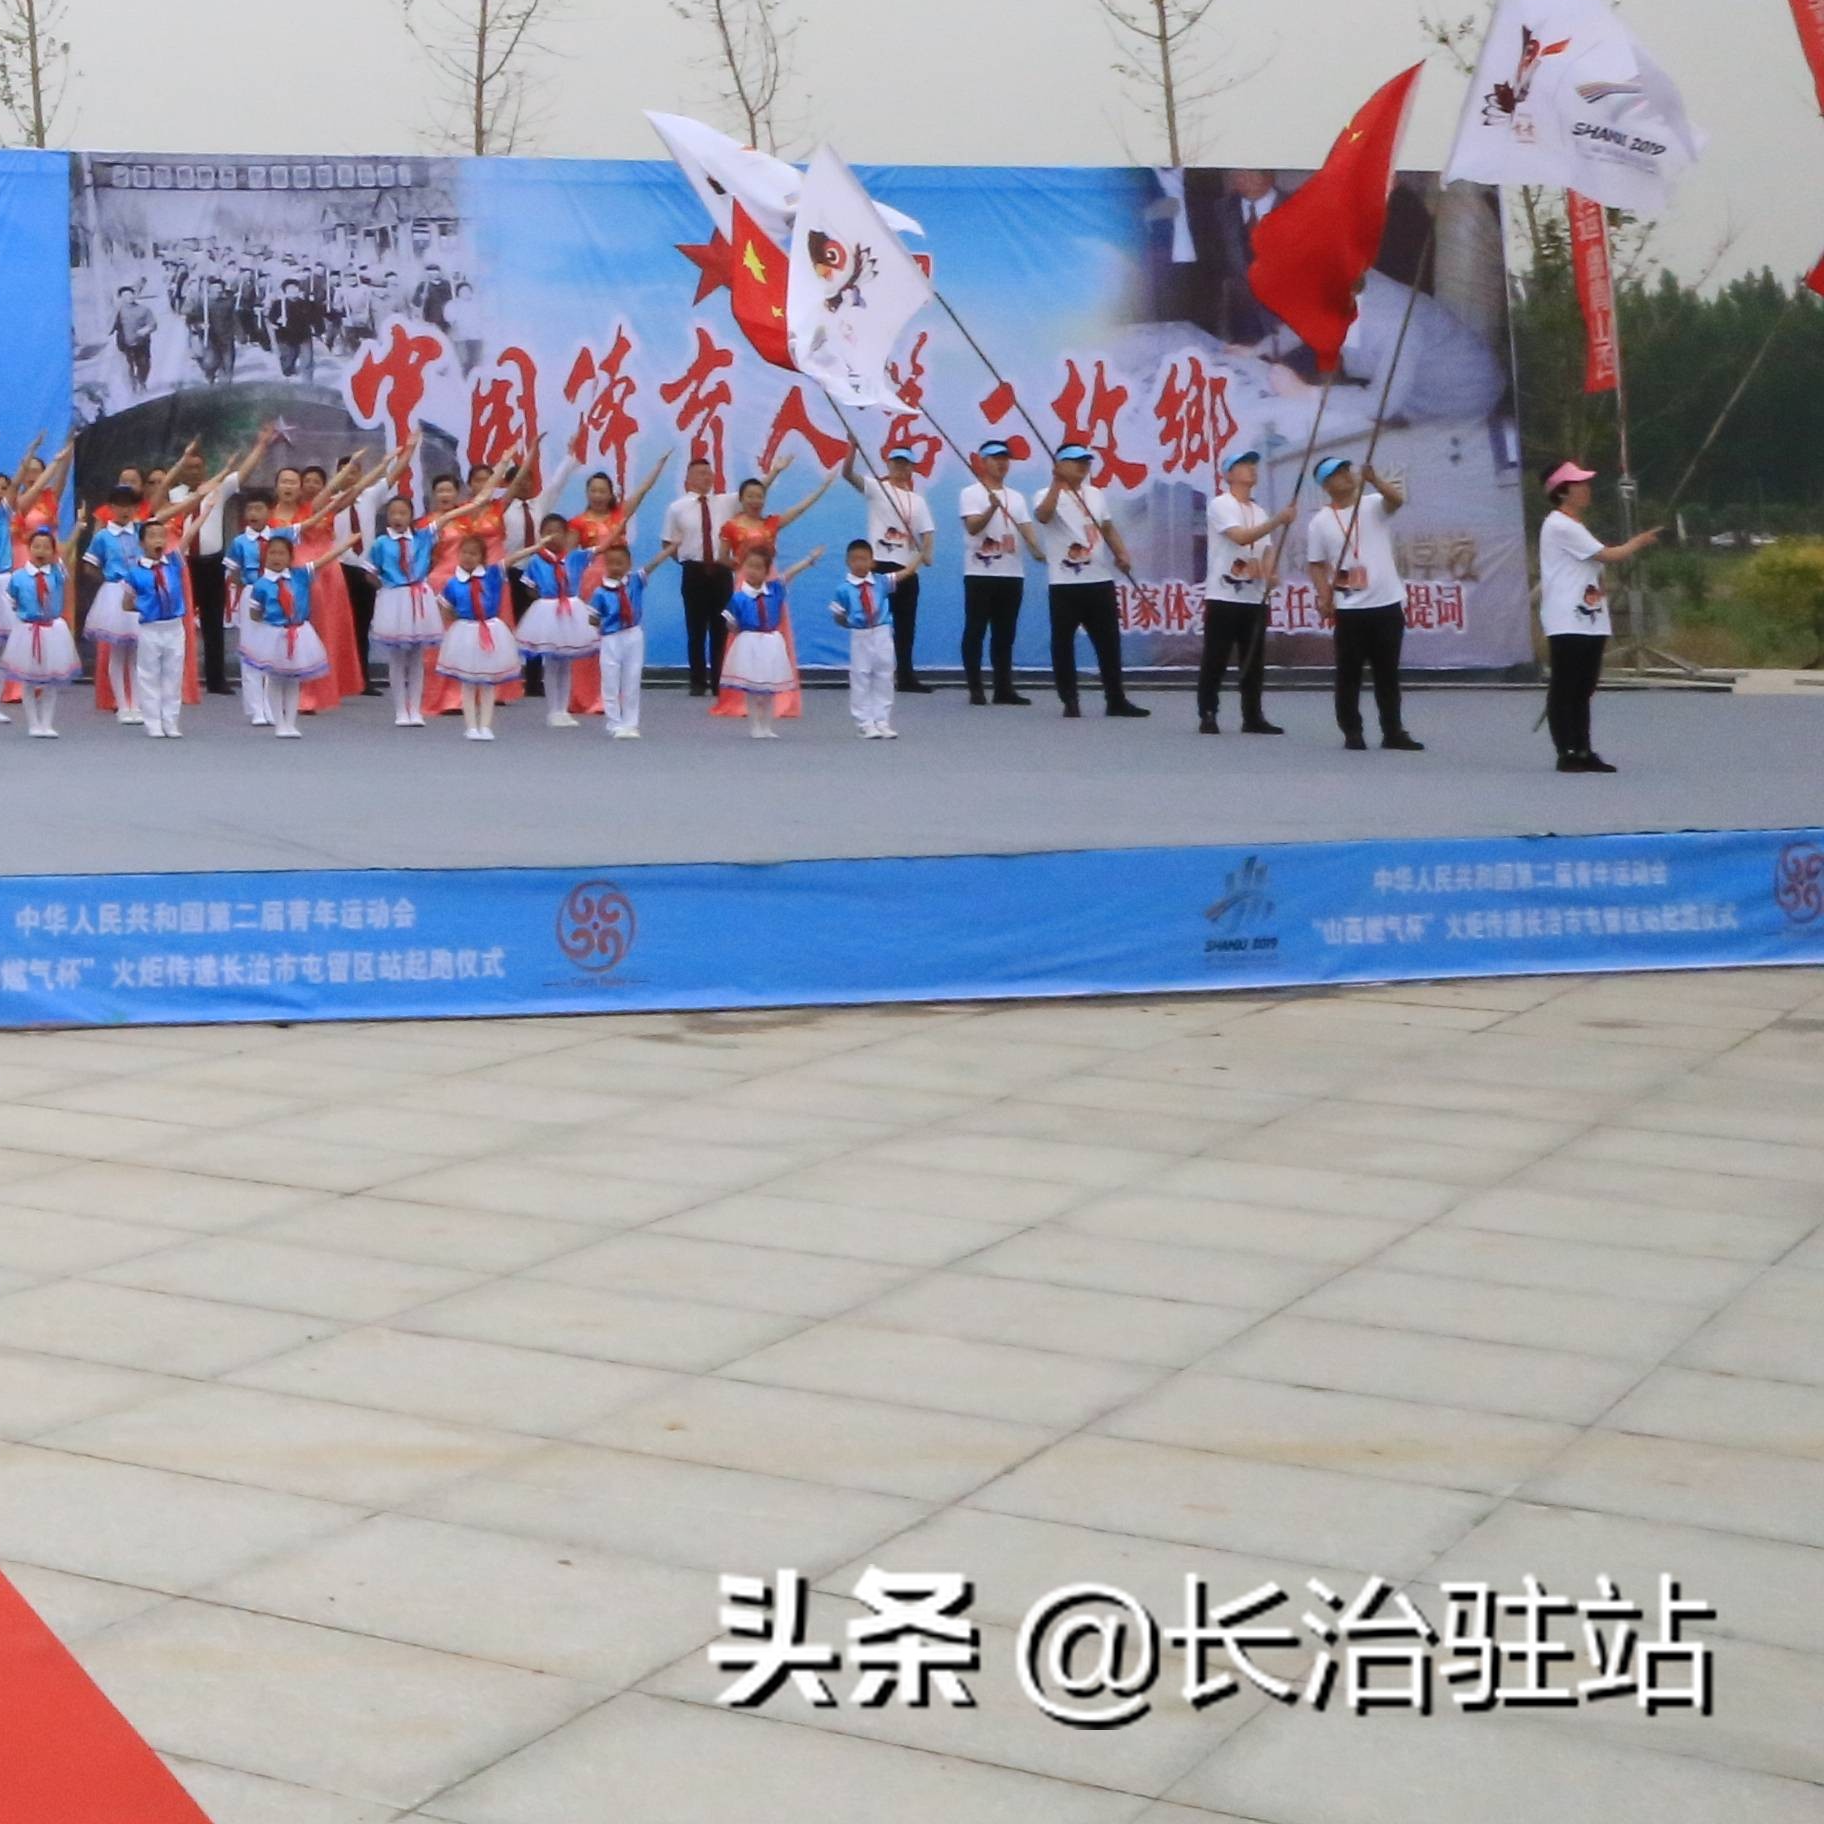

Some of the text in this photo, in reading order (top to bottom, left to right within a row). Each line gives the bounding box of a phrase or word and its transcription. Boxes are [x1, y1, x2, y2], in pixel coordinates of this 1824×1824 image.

[1630, 137, 1667, 156] 2019
[15, 897, 416, 937] 中华人民共和国第二届青年运动会
